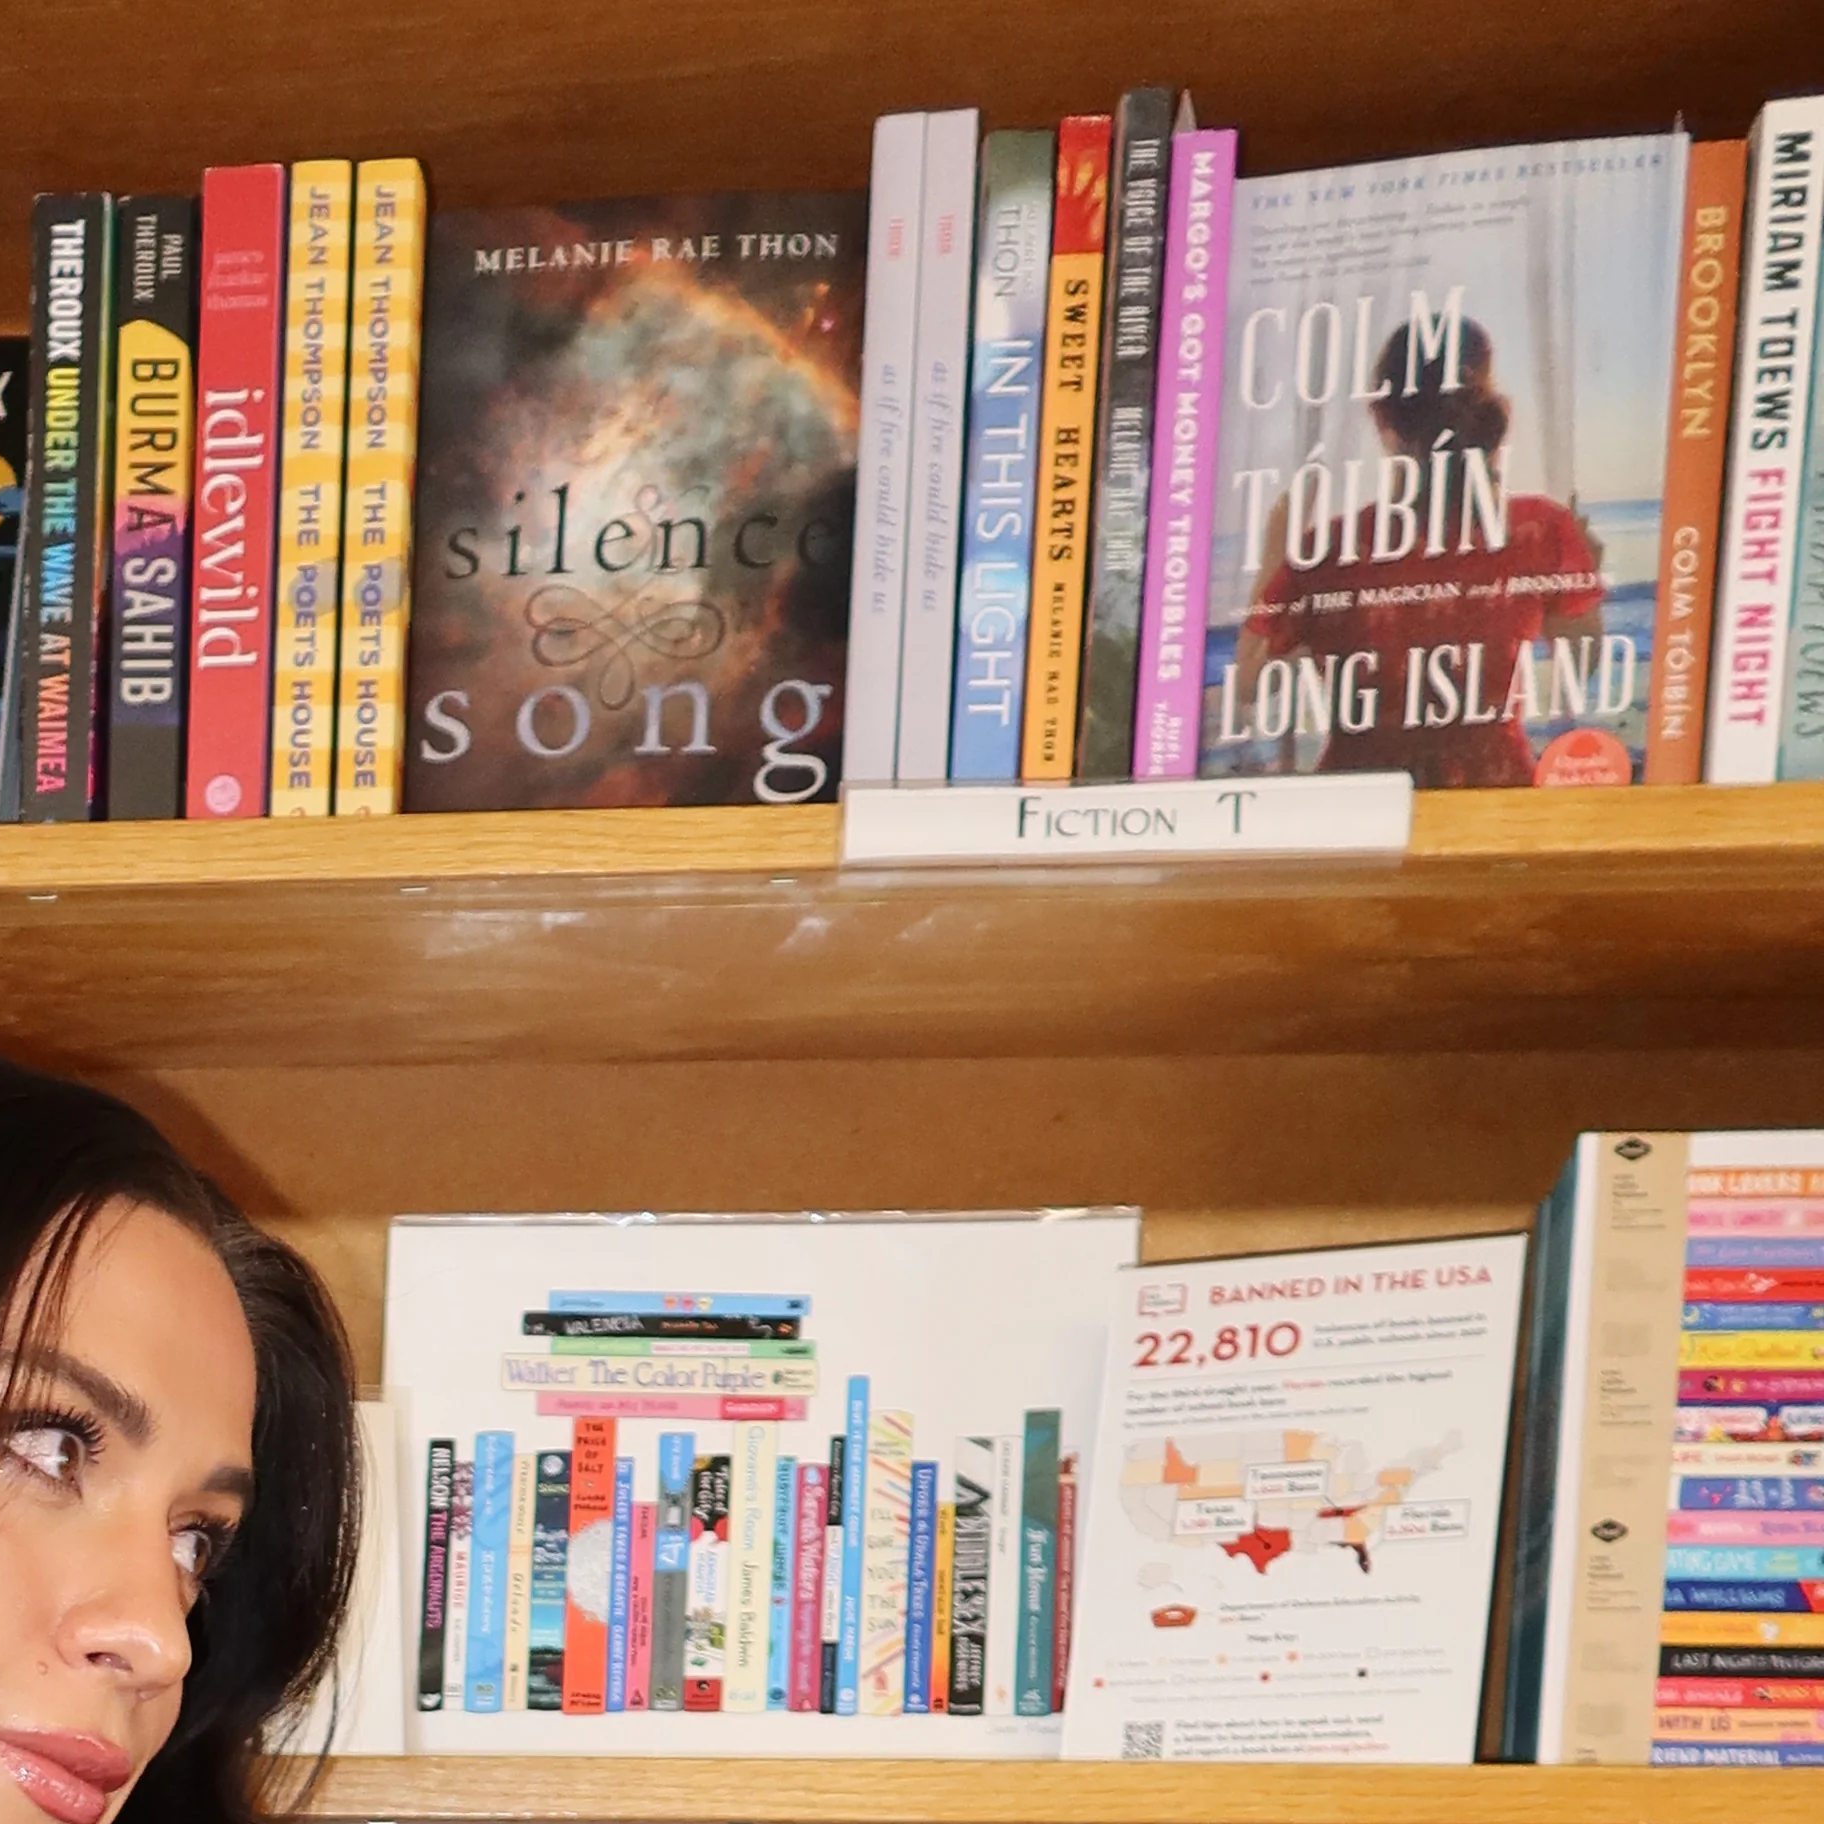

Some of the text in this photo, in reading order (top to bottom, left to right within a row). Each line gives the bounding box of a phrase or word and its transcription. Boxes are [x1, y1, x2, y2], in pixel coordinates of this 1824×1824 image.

[474, 233, 839, 274] MELANIE RAE THON
[1748, 129, 1816, 454] MIRIAM TOEWS
[1238, 287, 1468, 411] COLM
[35, 219, 87, 794] THEROUX UNDER THE WAVE AT WAIMEA
[119, 356, 184, 706] BURMA SAHIB
[197, 387, 264, 671] idlewild
[445, 484, 835, 581] silence
[967, 341, 1033, 727] IN THIS LIGHT
[1232, 429, 1517, 576] TÓIBÍN
[1728, 467, 1786, 727] FIGHT NIGHT
[420, 676, 835, 803] song
[1218, 633, 1639, 745] LONG ISLAND
[1215, 790, 1257, 835] T
[1133, 1321, 1300, 1368] 22,810
[1209, 1266, 1492, 1305] BANNED IN THE USA
[506, 1358, 577, 1385] Walker
[591, 1359, 627, 1384] The
[633, 1361, 696, 1388] Color
